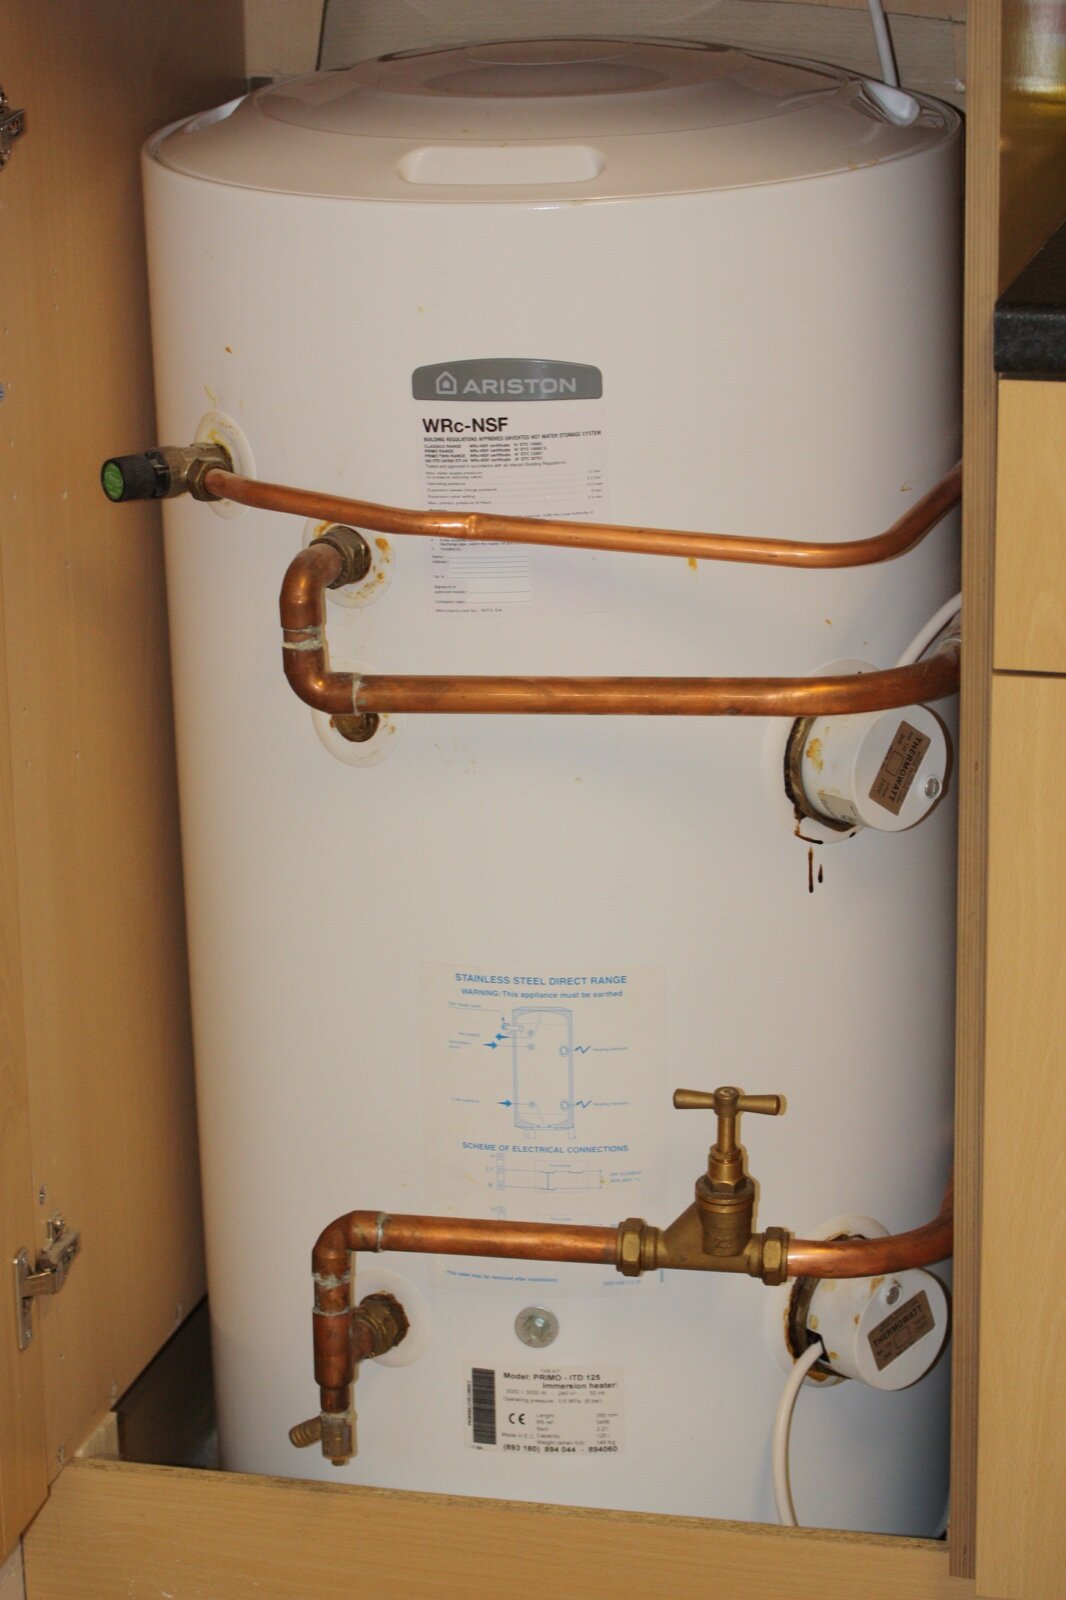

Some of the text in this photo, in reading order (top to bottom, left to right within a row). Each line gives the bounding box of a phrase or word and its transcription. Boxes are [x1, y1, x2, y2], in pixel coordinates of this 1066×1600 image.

[462, 378, 577, 394] ARISTON
[422, 416, 509, 433] WRc-NSF
[888, 737, 922, 802] THERMOWATT
[455, 973, 627, 985] STAINLESS STEEL DIRECT RANGE
[461, 988, 501, 997] WARNING:
[502, 990, 518, 998] This
[521, 991, 558, 999] appliance
[462, 1142, 629, 1154] SCHEME OF ELECTRICAL CONNECTIONS
[873, 1304, 922, 1347] THERMOWATT
[503, 1372, 530, 1380] Model:
[509, 1413, 526, 1425] CE
